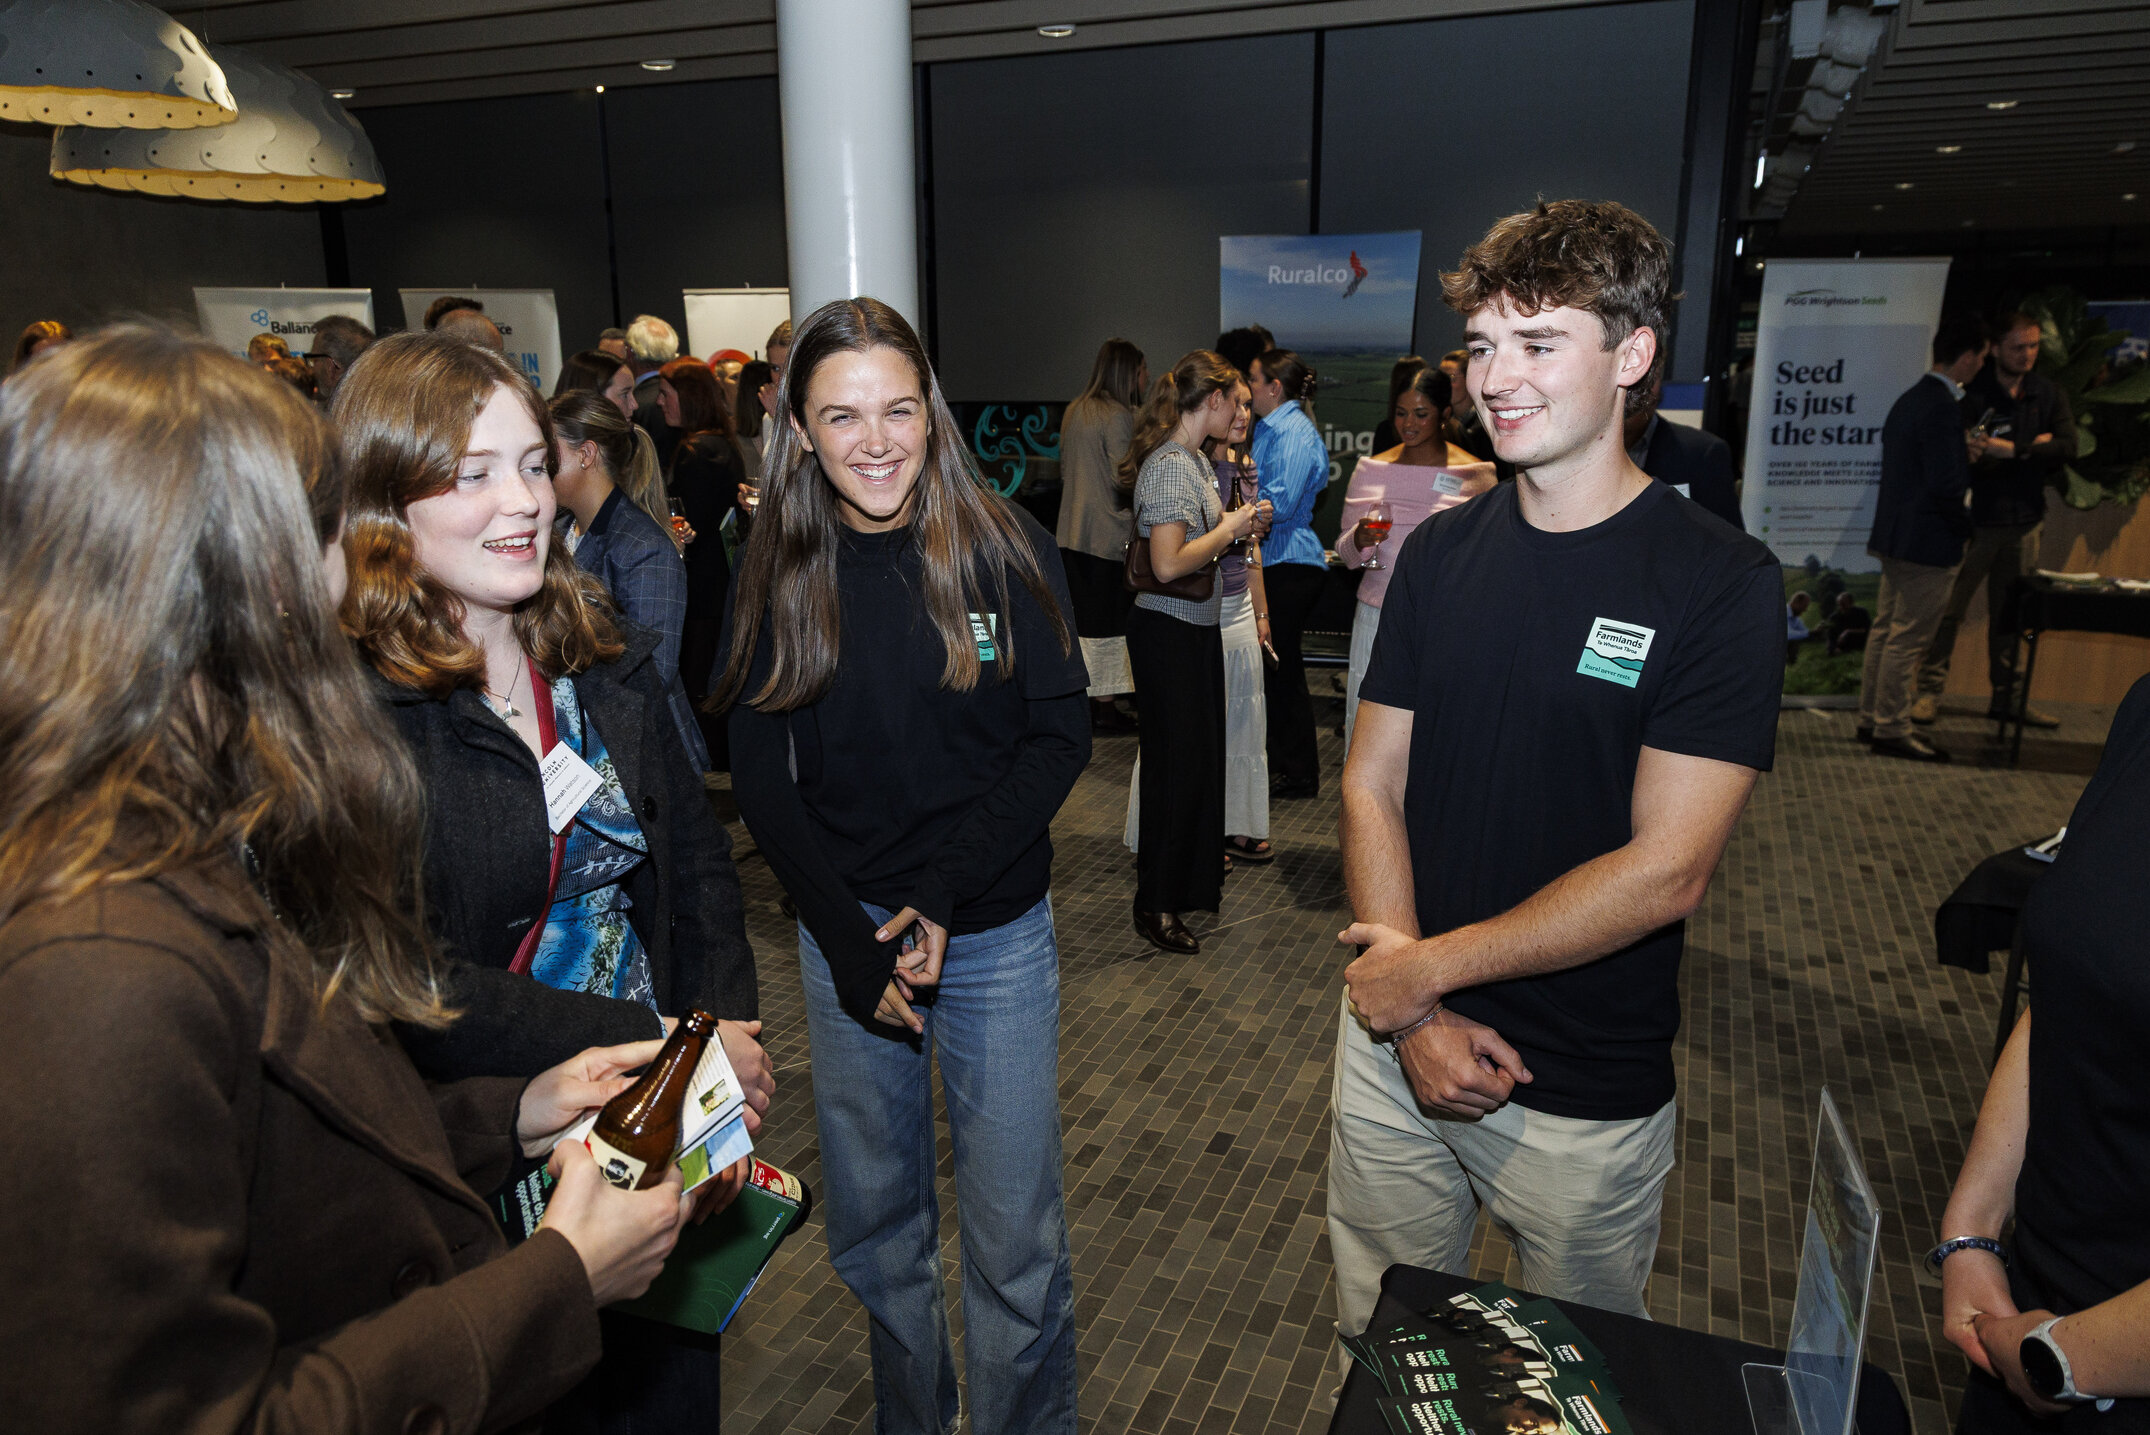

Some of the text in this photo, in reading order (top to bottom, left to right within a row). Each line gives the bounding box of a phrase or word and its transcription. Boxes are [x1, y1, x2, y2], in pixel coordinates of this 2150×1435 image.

[1268, 264, 1348, 284] Ruralco
[1809, 296, 1860, 307] Wrightson
[271, 321, 318, 334] Ballanc
[1776, 359, 1845, 384] Seed
[1773, 390, 1856, 421] is just
[1325, 423, 1375, 458] ing
[1771, 421, 1816, 446] the
[1596, 630, 1644, 649] Farmlands
[1584, 663, 1601, 672] Rural
[541, 760, 557, 777] NCOLN
[548, 788, 567, 808] Hannah
[1411, 1403, 1434, 1435] opportu
[1421, 1401, 1443, 1433] Neither
[1432, 1400, 1449, 1424] rests.
[1442, 1399, 1467, 1435] Rural nev
[1571, 1395, 1602, 1435] Farmlands
